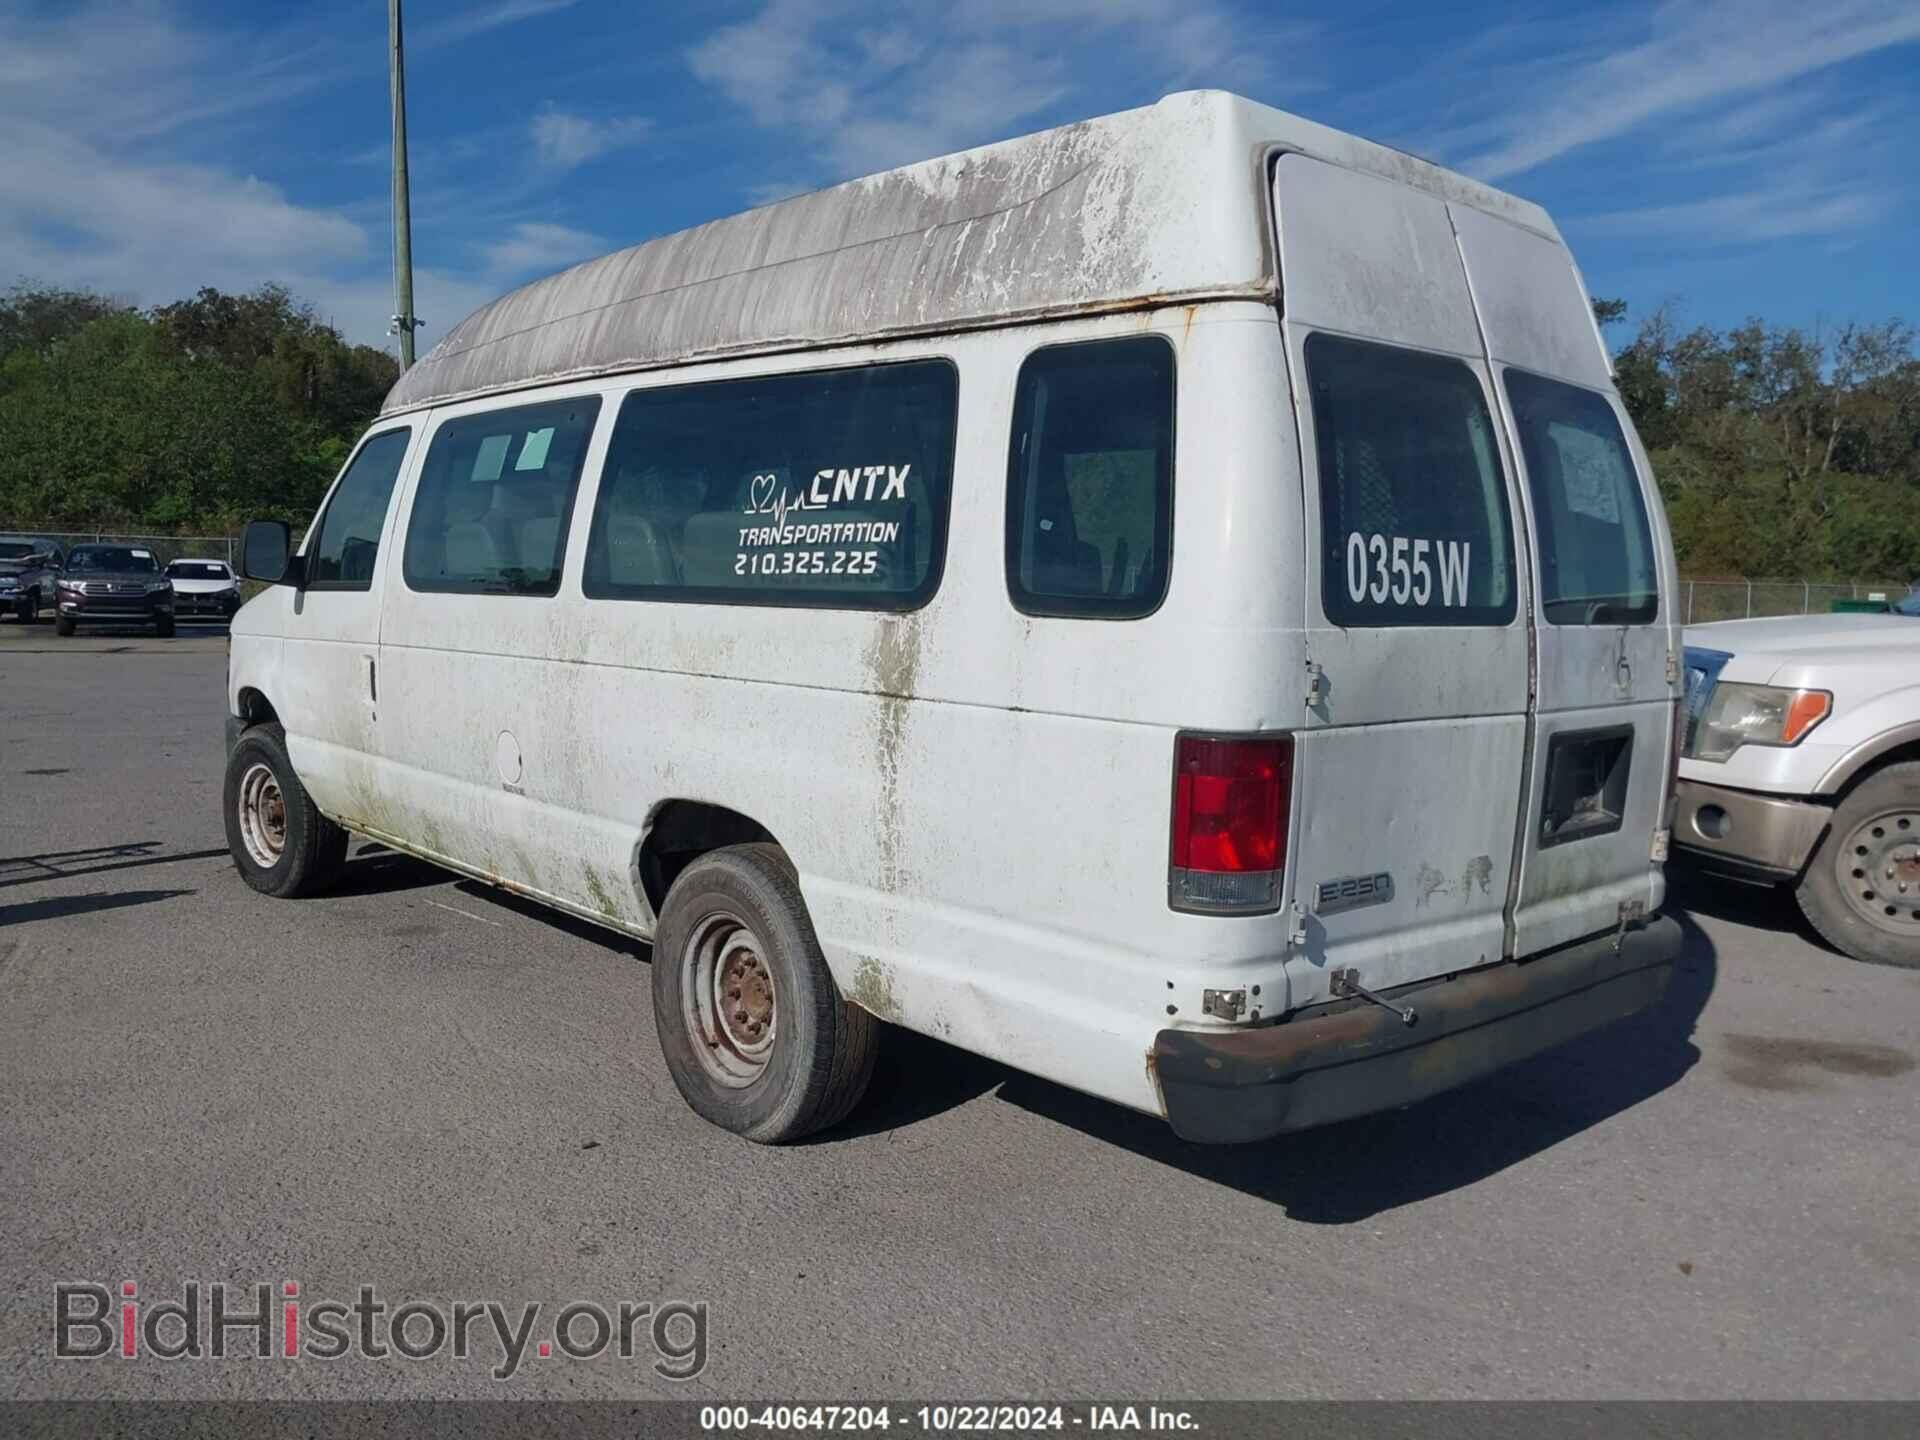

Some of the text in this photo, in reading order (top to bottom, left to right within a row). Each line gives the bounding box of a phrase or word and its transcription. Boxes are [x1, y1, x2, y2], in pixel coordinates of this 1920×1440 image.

[810, 464, 911, 503] CNTX
[739, 521, 900, 547] TRANSPORTATION
[734, 550, 878, 575] 210.325.225
